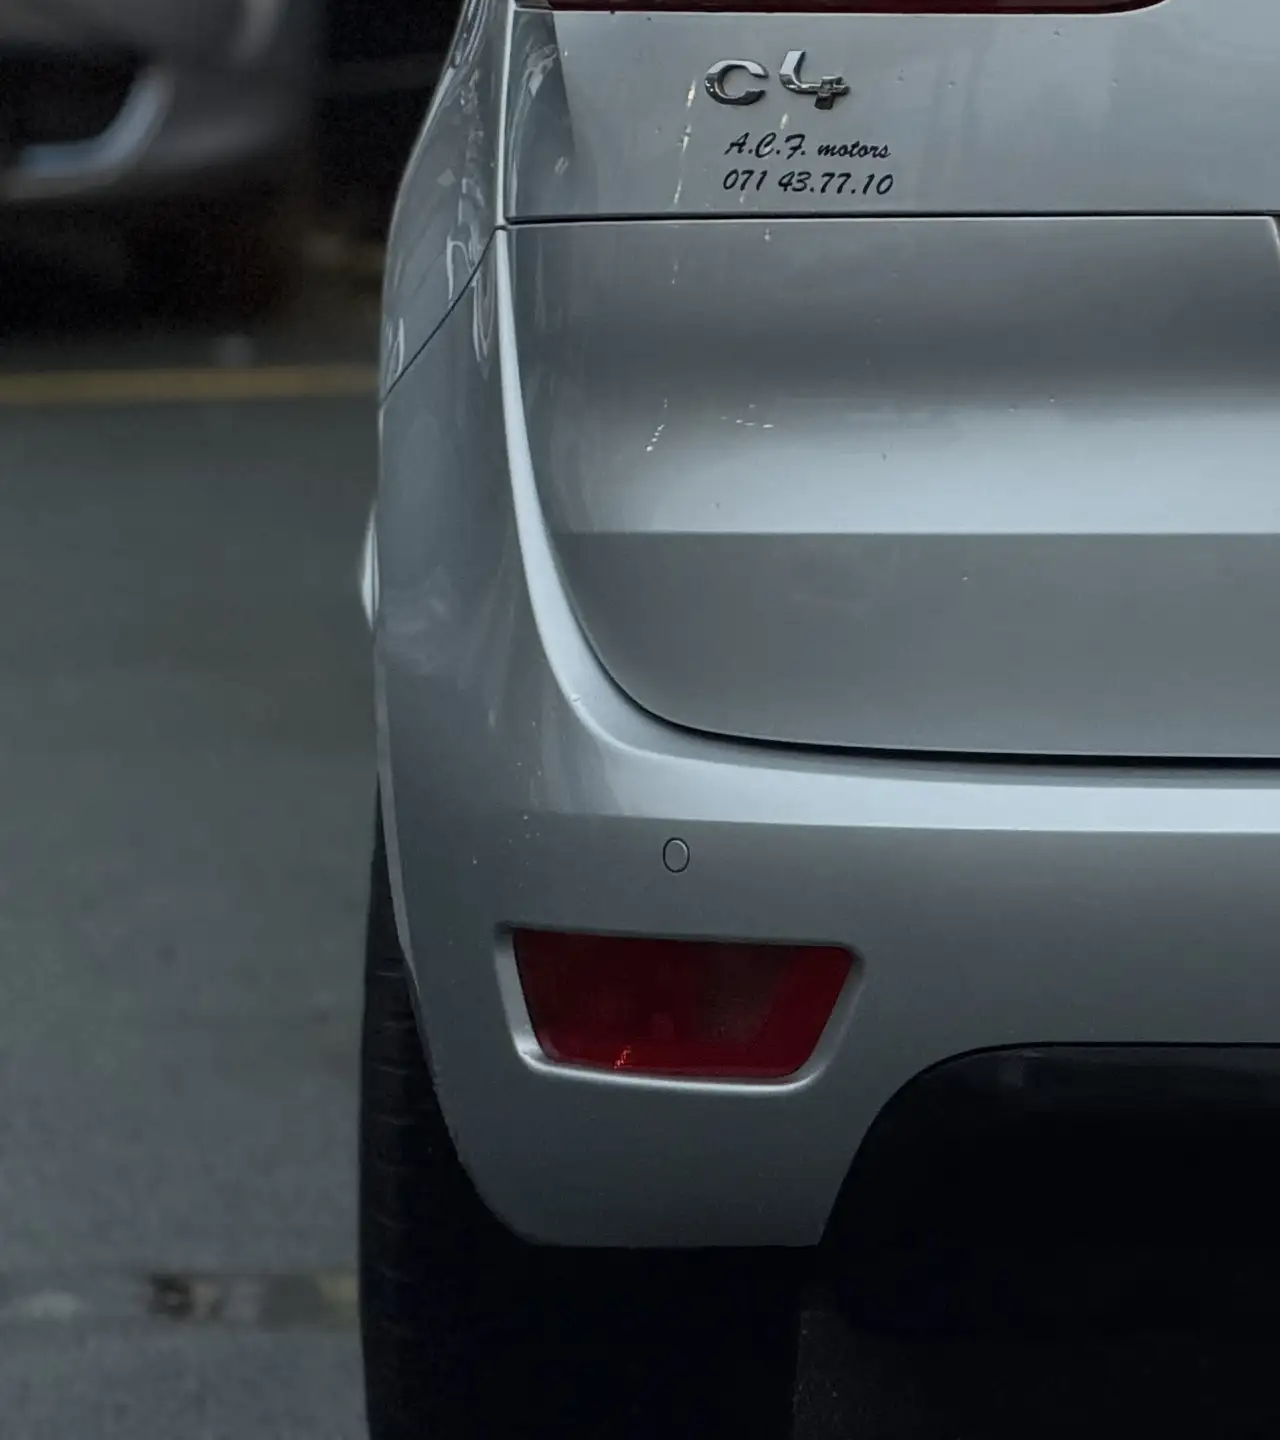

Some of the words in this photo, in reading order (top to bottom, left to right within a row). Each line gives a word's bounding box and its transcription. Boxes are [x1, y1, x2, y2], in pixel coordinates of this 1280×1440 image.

[705, 49, 851, 111] C4
[723, 131, 806, 160] A.C.F.
[817, 140, 892, 159] motors
[722, 168, 768, 192] 071
[777, 170, 894, 195] 43.77.10
